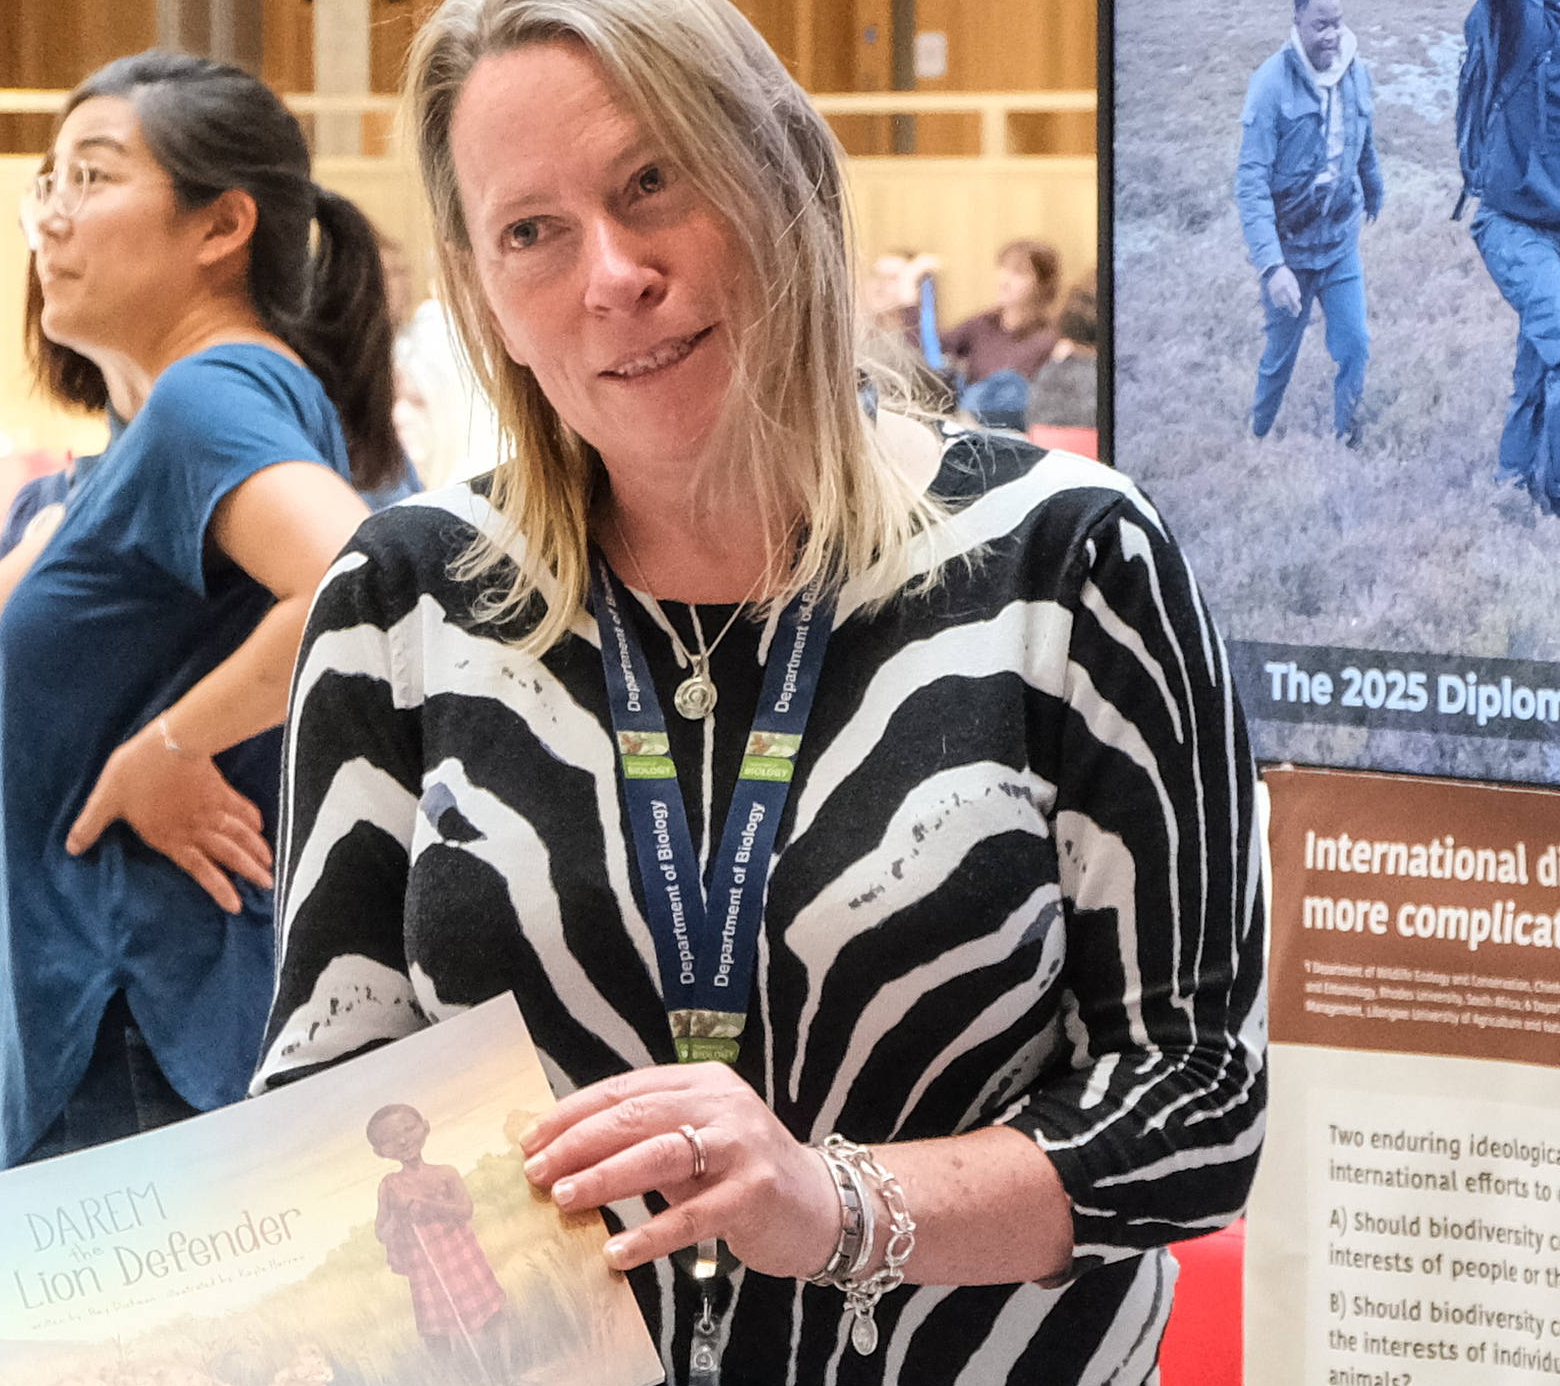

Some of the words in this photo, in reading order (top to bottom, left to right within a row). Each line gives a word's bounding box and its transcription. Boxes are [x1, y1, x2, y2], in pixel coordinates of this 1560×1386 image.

[612, 619, 641, 713] Department
[773, 628, 809, 714] Department
[1265, 662, 1333, 705] The
[1341, 668, 1429, 713] 2025
[743, 766, 791, 779] BIOLOGY
[649, 800, 674, 860] Biology
[734, 801, 767, 865] Biology
[661, 861, 676, 884] of
[731, 864, 747, 889] of
[1304, 830, 1529, 886] International
[663, 885, 696, 986] Department
[713, 890, 747, 989] Department
[1303, 895, 1388, 935] more
[1329, 1124, 1364, 1148] Two
[1371, 1130, 1462, 1160] enduring
[1329, 1159, 1458, 1192] international
[1465, 1171, 1529, 1199] efforts
[1535, 1180, 1552, 1202] to
[24, 1180, 169, 1253] DAREM
[1329, 1206, 1348, 1237] A)
[1354, 1211, 1421, 1238] Should
[1429, 1217, 1544, 1255] biodiversity
[13, 1263, 104, 1310] Lion
[114, 1206, 303, 1288] Defender
[68, 1241, 104, 1263] the
[1329, 1242, 1414, 1274] interests
[1422, 1253, 1444, 1275] of
[1452, 1257, 1519, 1285] people
[1523, 1266, 1540, 1285] or
[1329, 1292, 1347, 1321] B)
[1353, 1295, 1421, 1322] Should
[1430, 1301, 1545, 1340] biodiversity
[1328, 1329, 1358, 1353] the
[1363, 1331, 1459, 1361] interests
[1466, 1342, 1487, 1363] of
